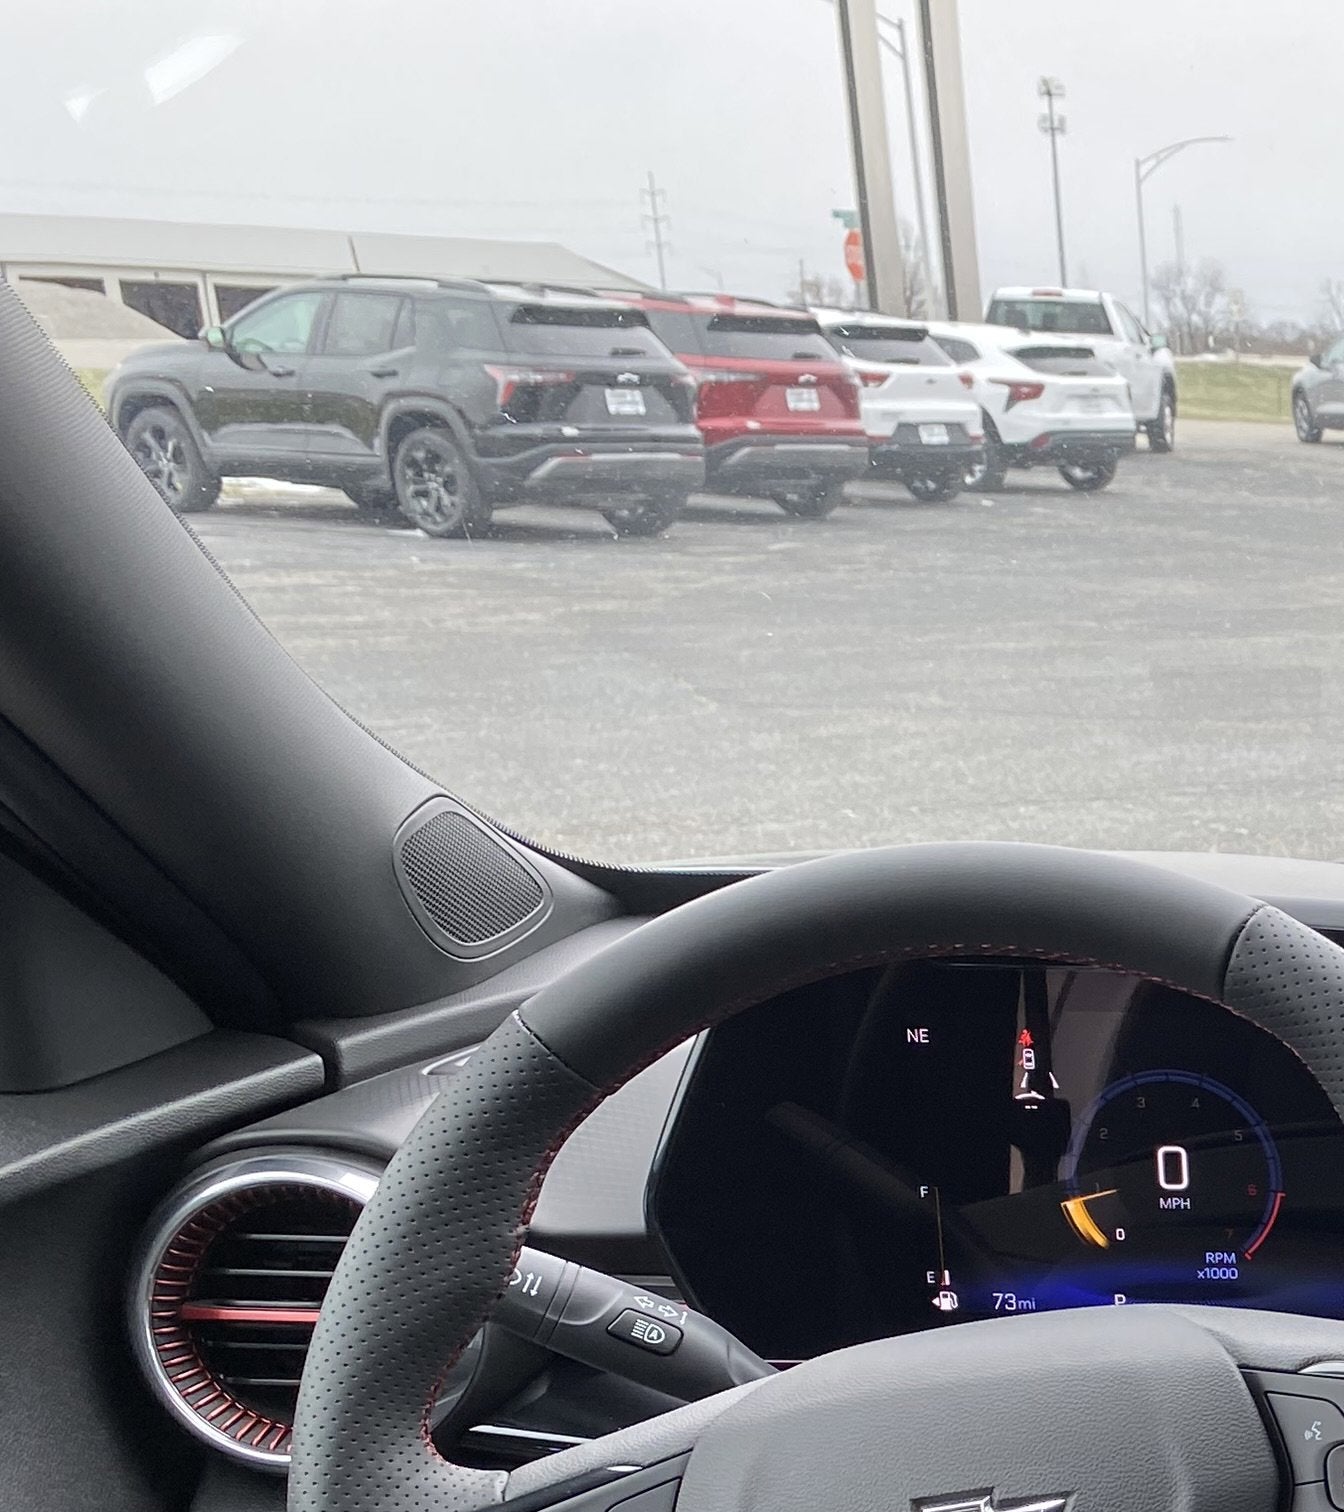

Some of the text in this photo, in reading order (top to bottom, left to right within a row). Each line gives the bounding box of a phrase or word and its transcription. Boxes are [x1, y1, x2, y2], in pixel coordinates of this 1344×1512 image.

[906, 1028, 930, 1044] NE
[1156, 1145, 1190, 1190] 0
[920, 1186, 929, 1198] F
[1159, 1197, 1191, 1210] MPH
[1205, 1252, 1237, 1264] RPM
[927, 1271, 935, 1284] E
[1197, 1267, 1239, 1281] x1000
